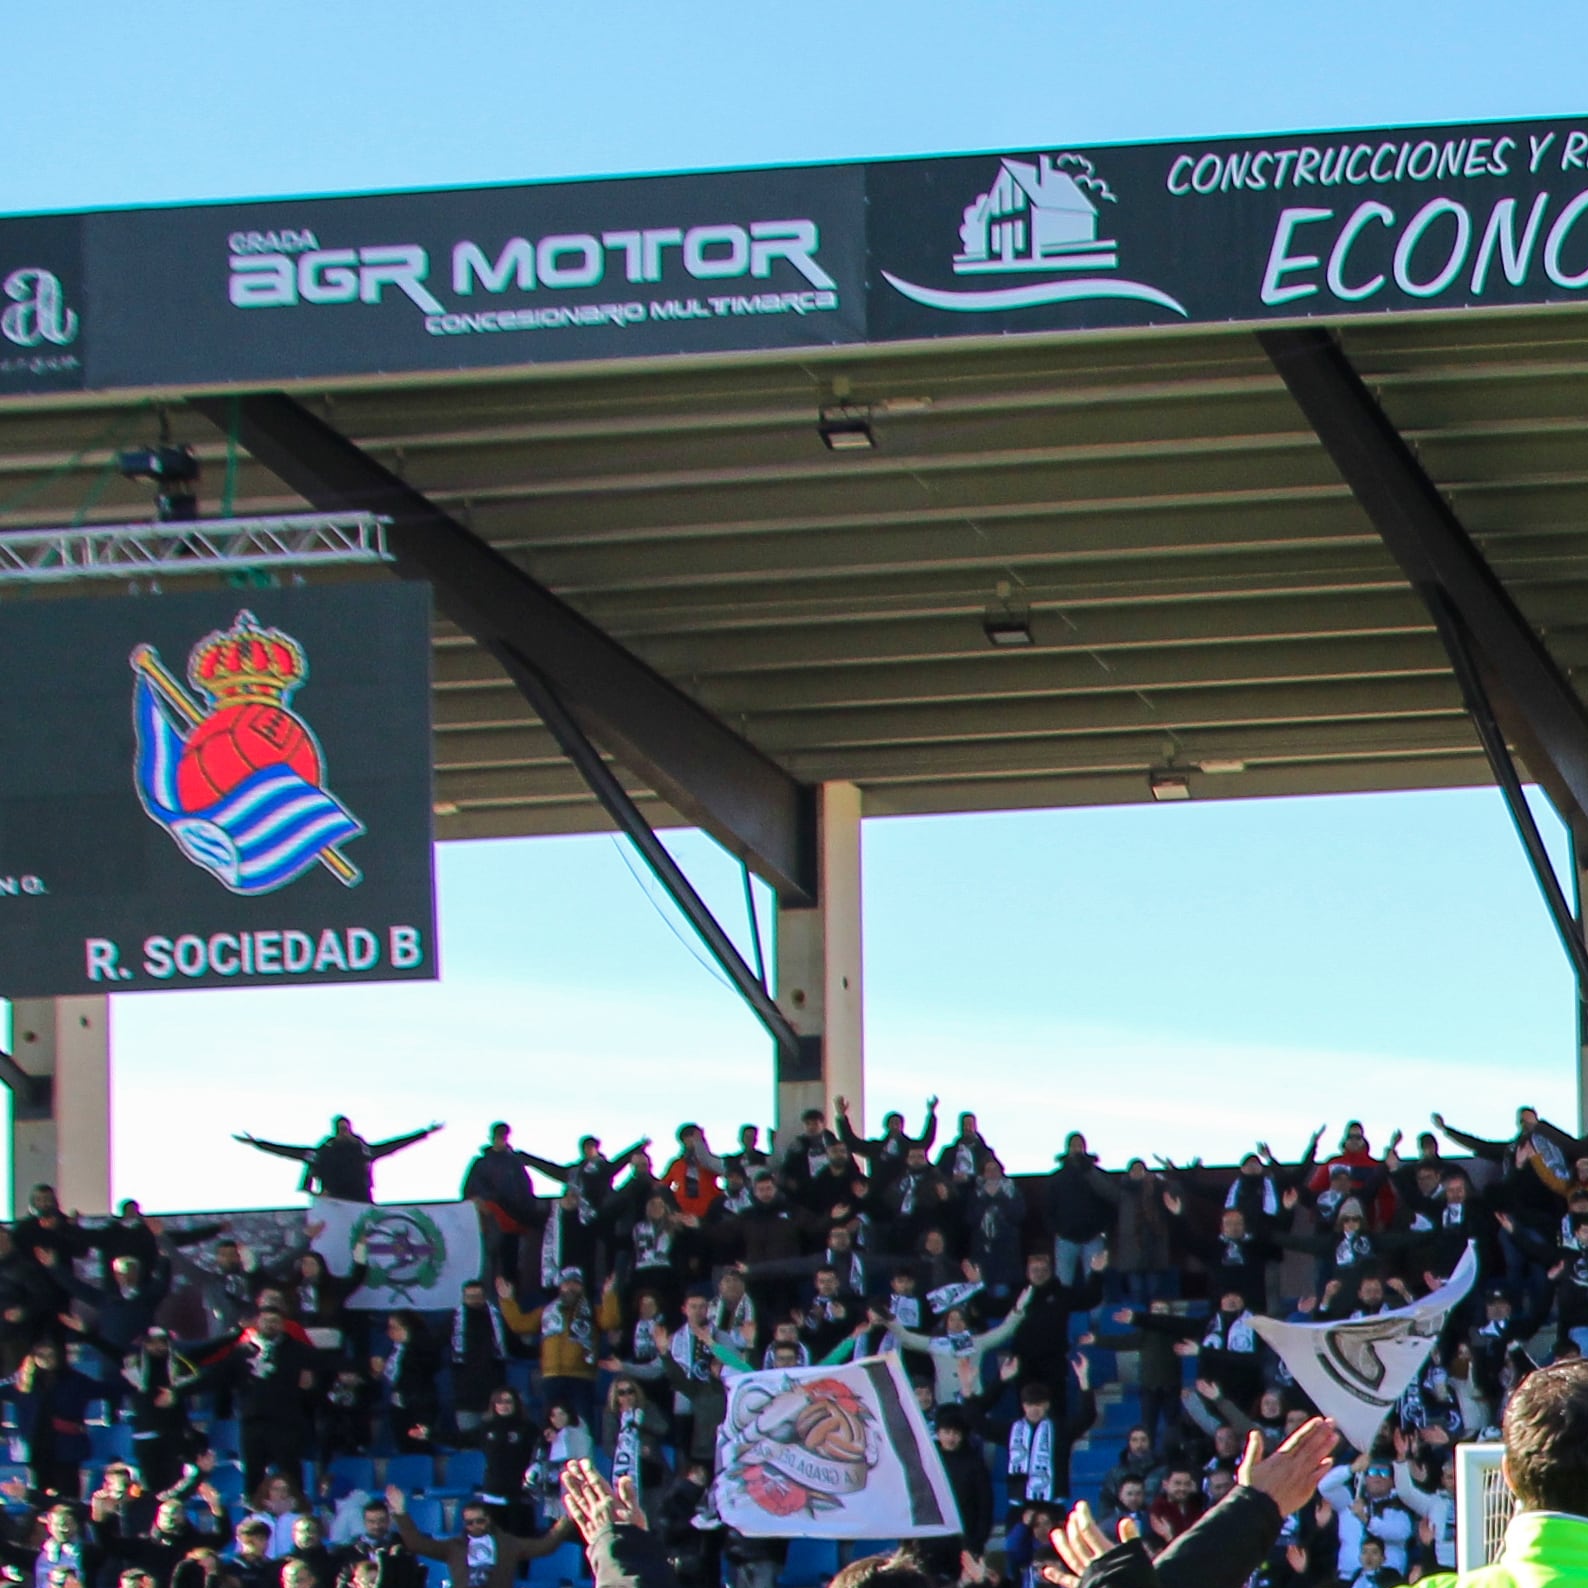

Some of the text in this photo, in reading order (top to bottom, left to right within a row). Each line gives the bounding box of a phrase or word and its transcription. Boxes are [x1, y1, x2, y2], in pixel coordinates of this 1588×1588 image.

[1165, 138, 1514, 195] CONSTRUCCIONES
[1527, 132, 1555, 173] Y
[228, 231, 320, 254] GRADA
[452, 220, 838, 298] MOTOR
[86, 925, 422, 981] R. SOCIEDAD B
